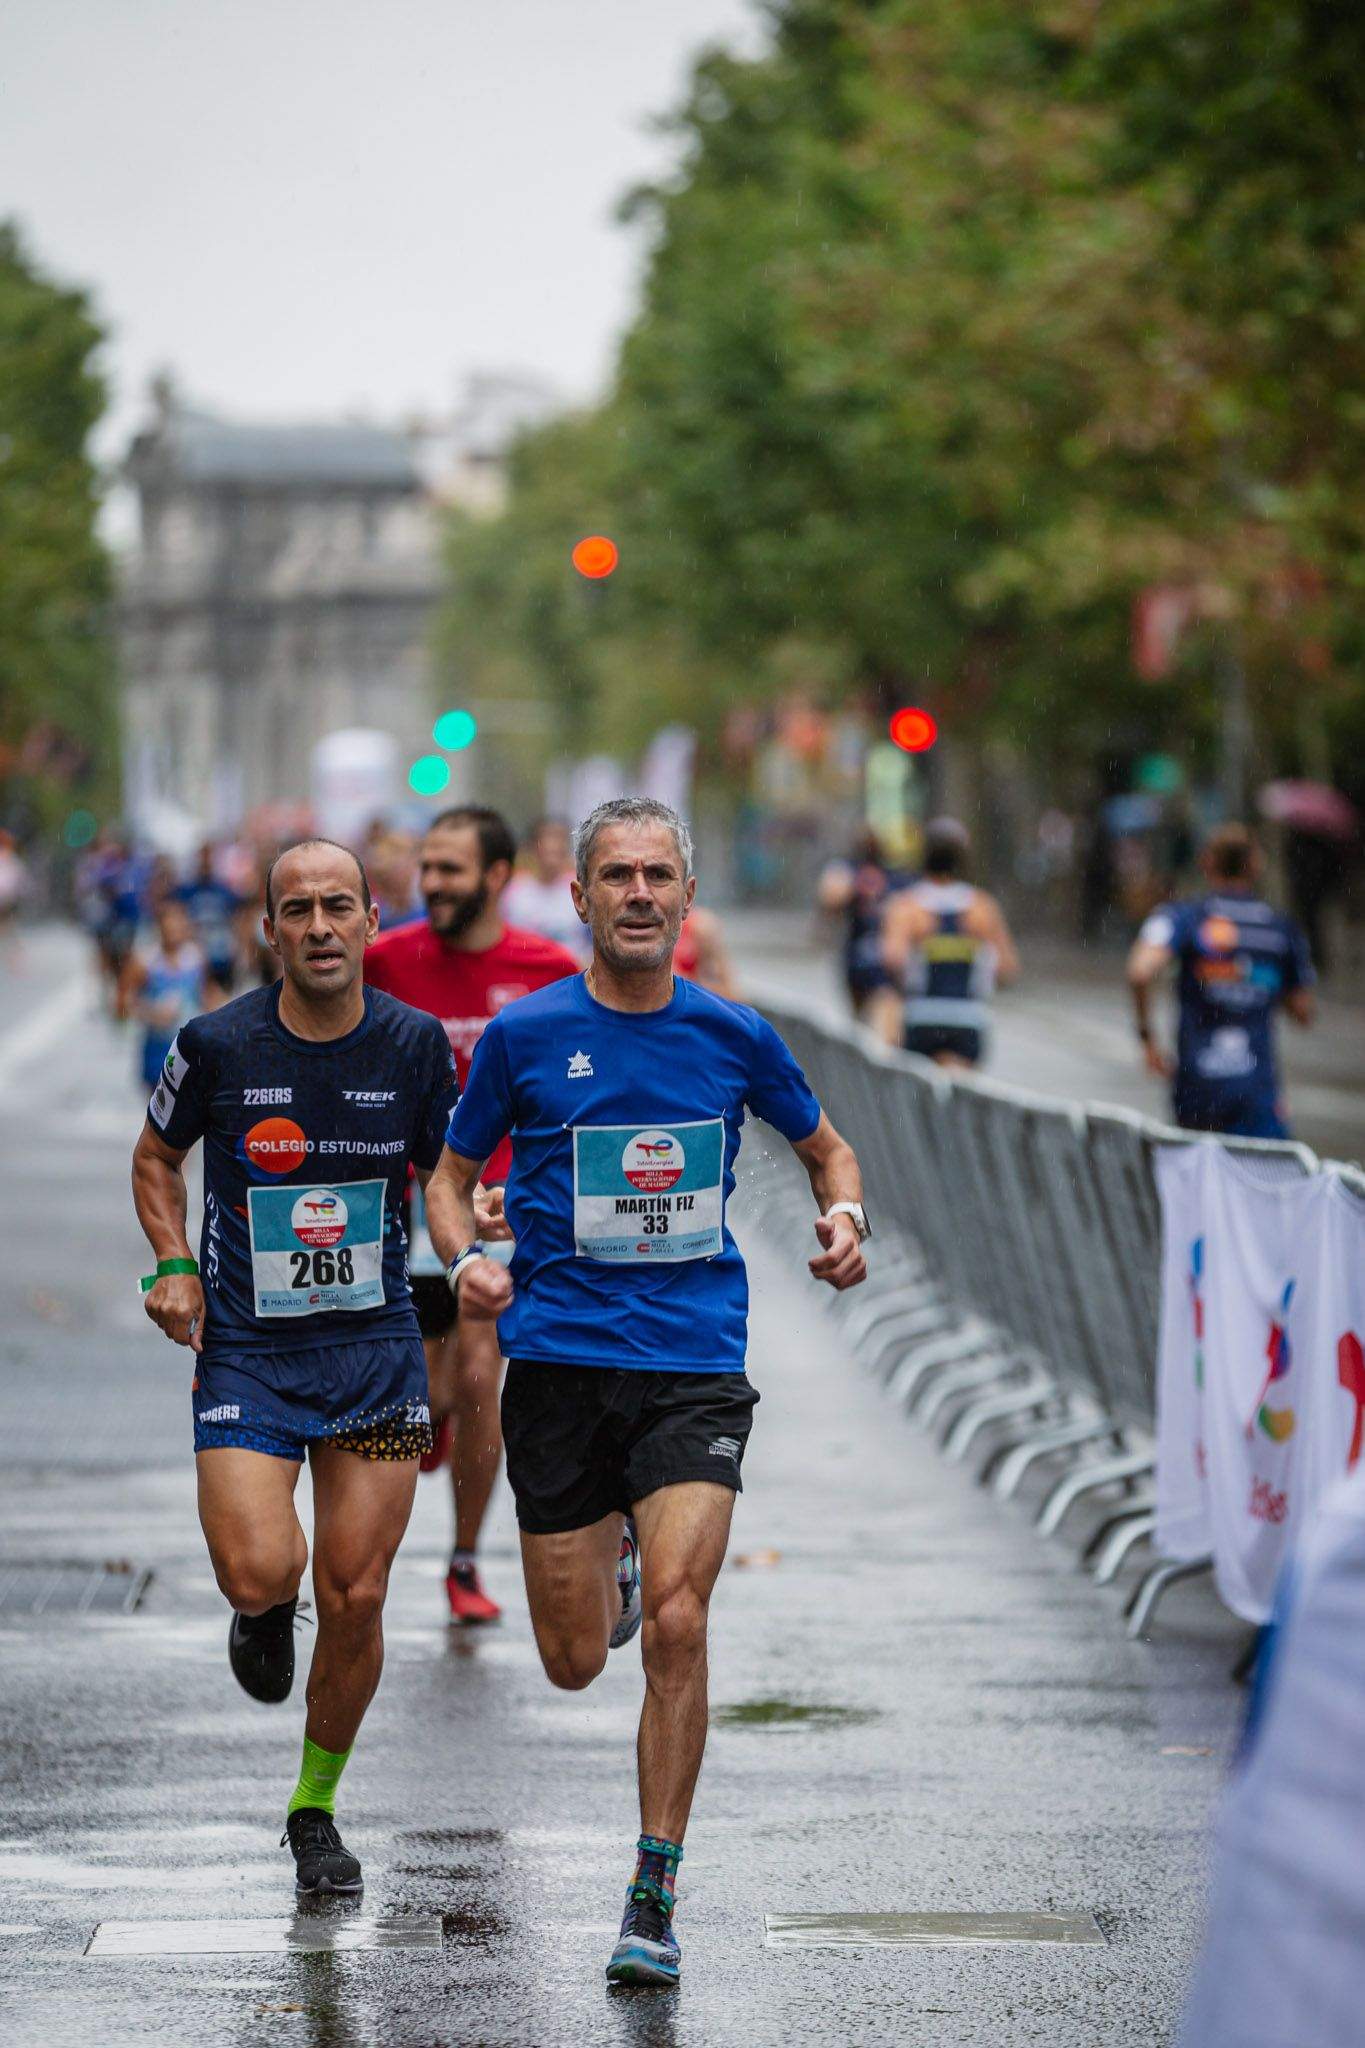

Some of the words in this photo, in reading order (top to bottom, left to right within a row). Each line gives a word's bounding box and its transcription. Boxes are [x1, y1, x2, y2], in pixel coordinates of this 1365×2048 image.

[243, 1087, 293, 1106] 226ERS
[342, 1090, 397, 1101] TREK
[249, 1139, 315, 1153] COLEGIO
[319, 1140, 405, 1156] ESTUDIANTES
[615, 1194, 672, 1214] MARTÍN
[676, 1195, 694, 1212] FIZ
[643, 1214, 669, 1235] 33
[593, 1244, 628, 1253] MADRID
[290, 1247, 355, 1289] 268
[270, 1299, 302, 1307] MADRID
